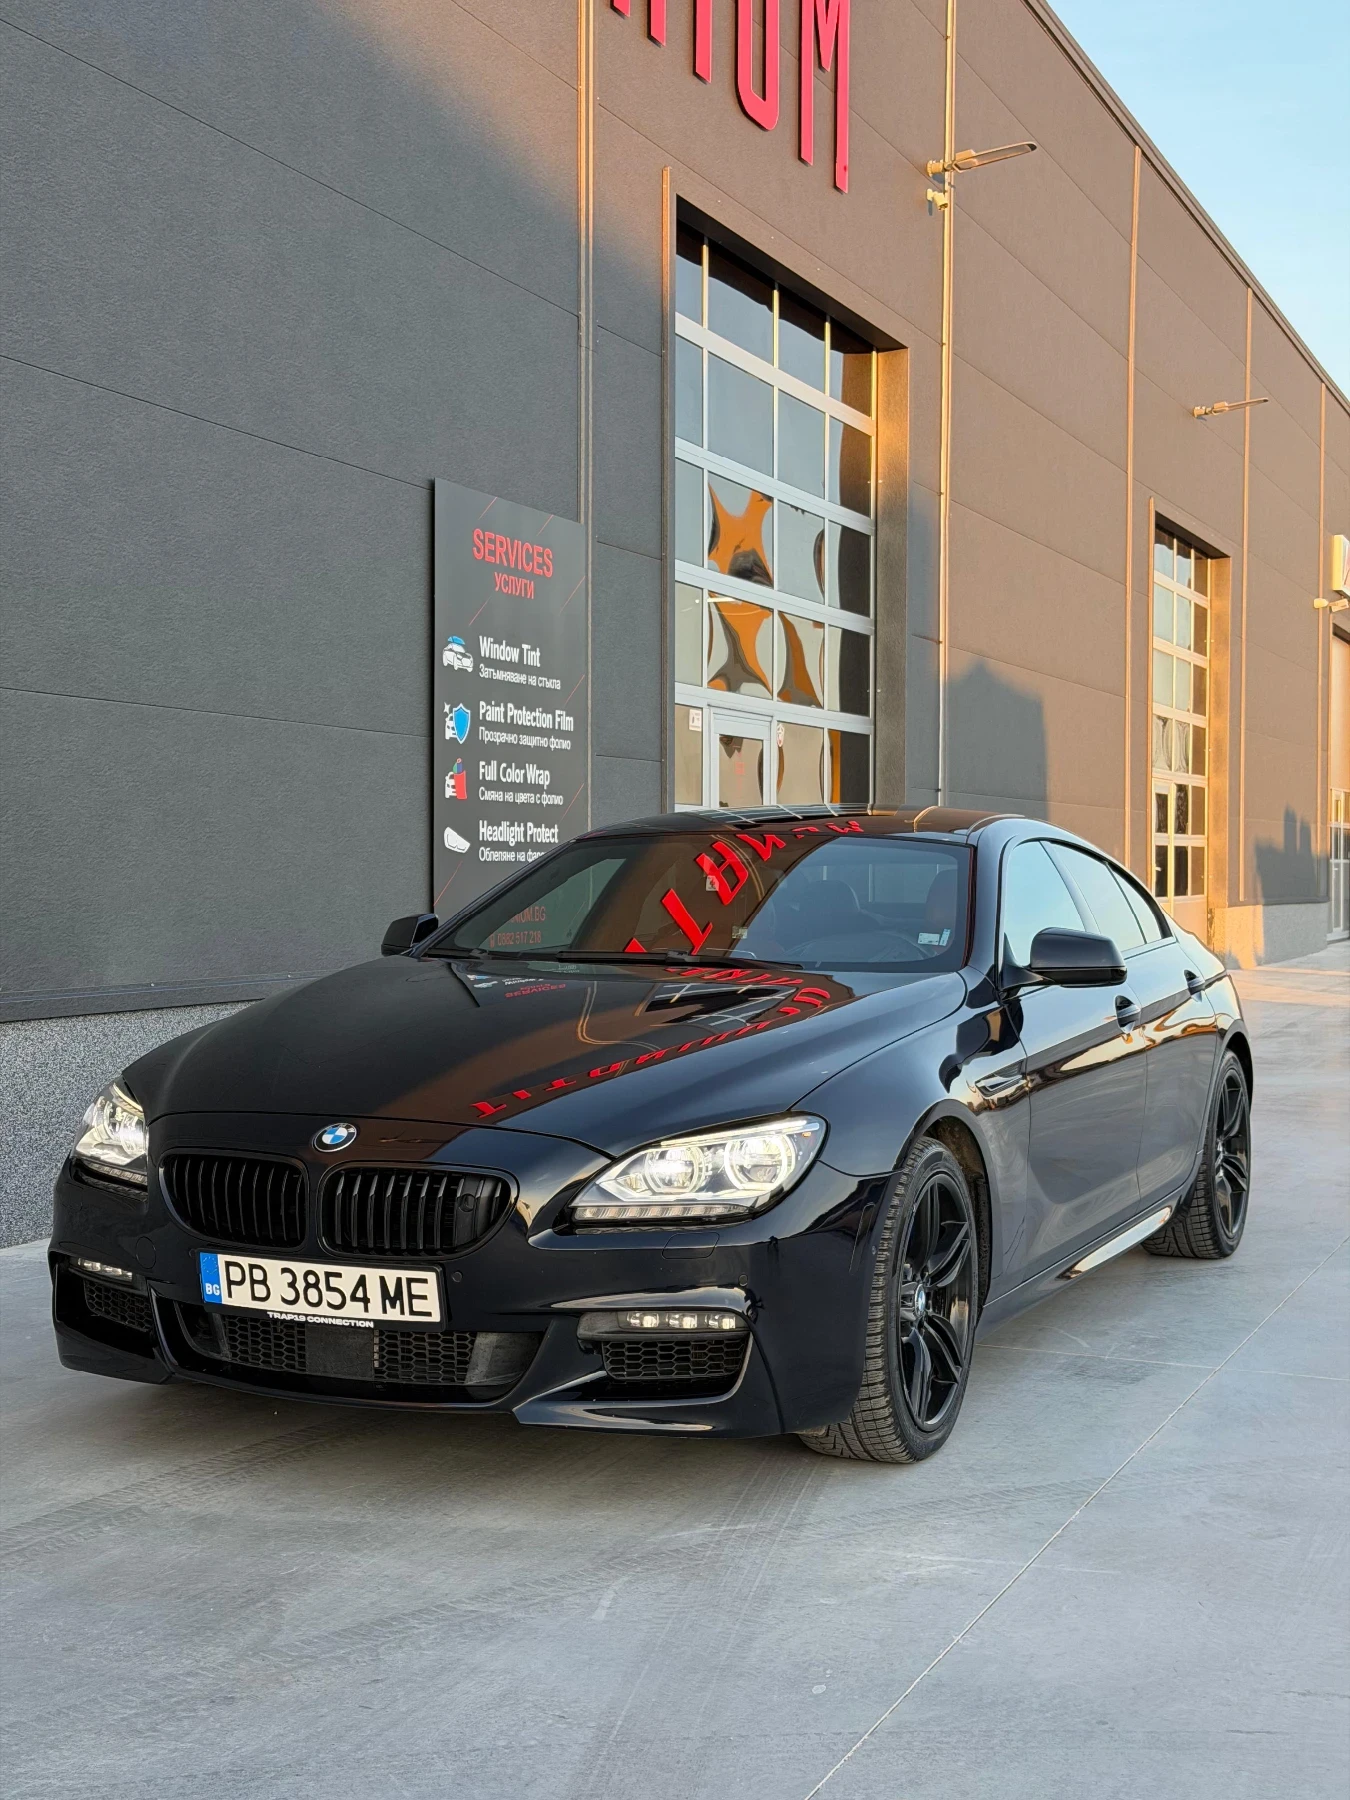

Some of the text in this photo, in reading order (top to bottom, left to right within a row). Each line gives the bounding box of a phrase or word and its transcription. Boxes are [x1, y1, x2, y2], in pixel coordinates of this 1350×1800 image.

[472, 528, 553, 578] SERVICES
[494, 572, 535, 600] УСЛУГИ
[479, 635, 541, 668] Window Tint
[479, 663, 561, 690] Затъмняване на стъкла
[479, 701, 574, 732] Paint Protection Film
[479, 727, 571, 750] Прозрачно защитно фолио
[479, 761, 550, 789] Full Color Wrap
[479, 786, 503, 802] Смяна
[504, 792, 514, 803] на
[514, 792, 535, 805] цвета
[541, 791, 564, 807] фолио
[479, 820, 559, 846] Headlight Protect
[479, 846, 516, 862] Облепяне
[516, 851, 526, 862] на
[205, 1283, 220, 1296] BG
[224, 1260, 433, 1318] PB 3854 ME
[306, 1315, 374, 1328] CONNECTION
